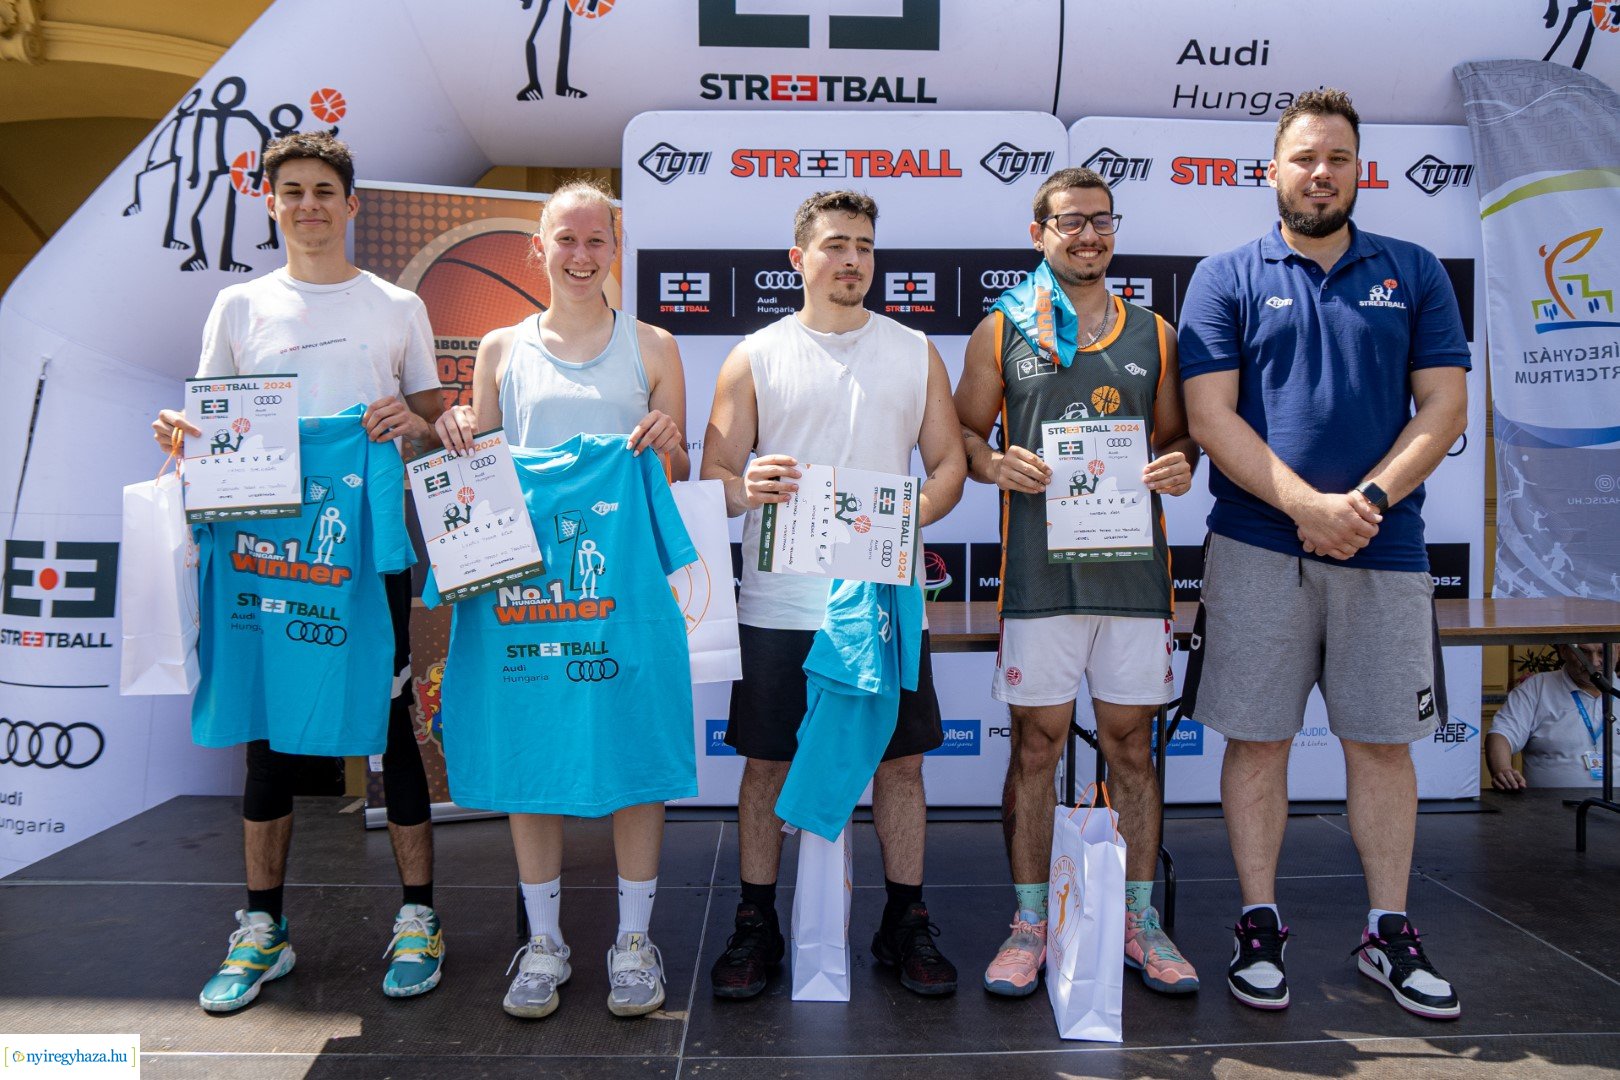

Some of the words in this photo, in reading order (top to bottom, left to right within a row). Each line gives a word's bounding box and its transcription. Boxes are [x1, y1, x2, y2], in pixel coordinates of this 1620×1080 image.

[1176, 39, 1269, 66] Audi
[700, 73, 937, 104] STREETBALL
[1173, 84, 1295, 115] Hunga
[655, 151, 712, 175] TOTI
[730, 149, 962, 177] STREETBALL
[997, 150, 1054, 175] TOTI
[1098, 157, 1152, 181] TOTI
[1419, 164, 1474, 188] TOTI
[660, 305, 709, 313] STREETBALL
[885, 305, 935, 313] STREETBALL
[1359, 300, 1406, 309] STREETBALL
[191, 382, 259, 393] STREETBALL
[263, 381, 292, 389] 2024
[1048, 425, 1110, 435] STREETBALL
[1114, 424, 1140, 432] 2024
[475, 437, 501, 452] 2024
[899, 481, 912, 547] STREETBALL
[897, 551, 907, 579] 2024
[512, 598, 551, 606] HUNGARY
[230, 612, 256, 620] Audi
[0, 628, 113, 648] STREETBALL
[507, 641, 609, 658] STREETBALL
[502, 665, 527, 673] Audi
[503, 674, 549, 684] Hungaria
[0, 791, 23, 806] udi
